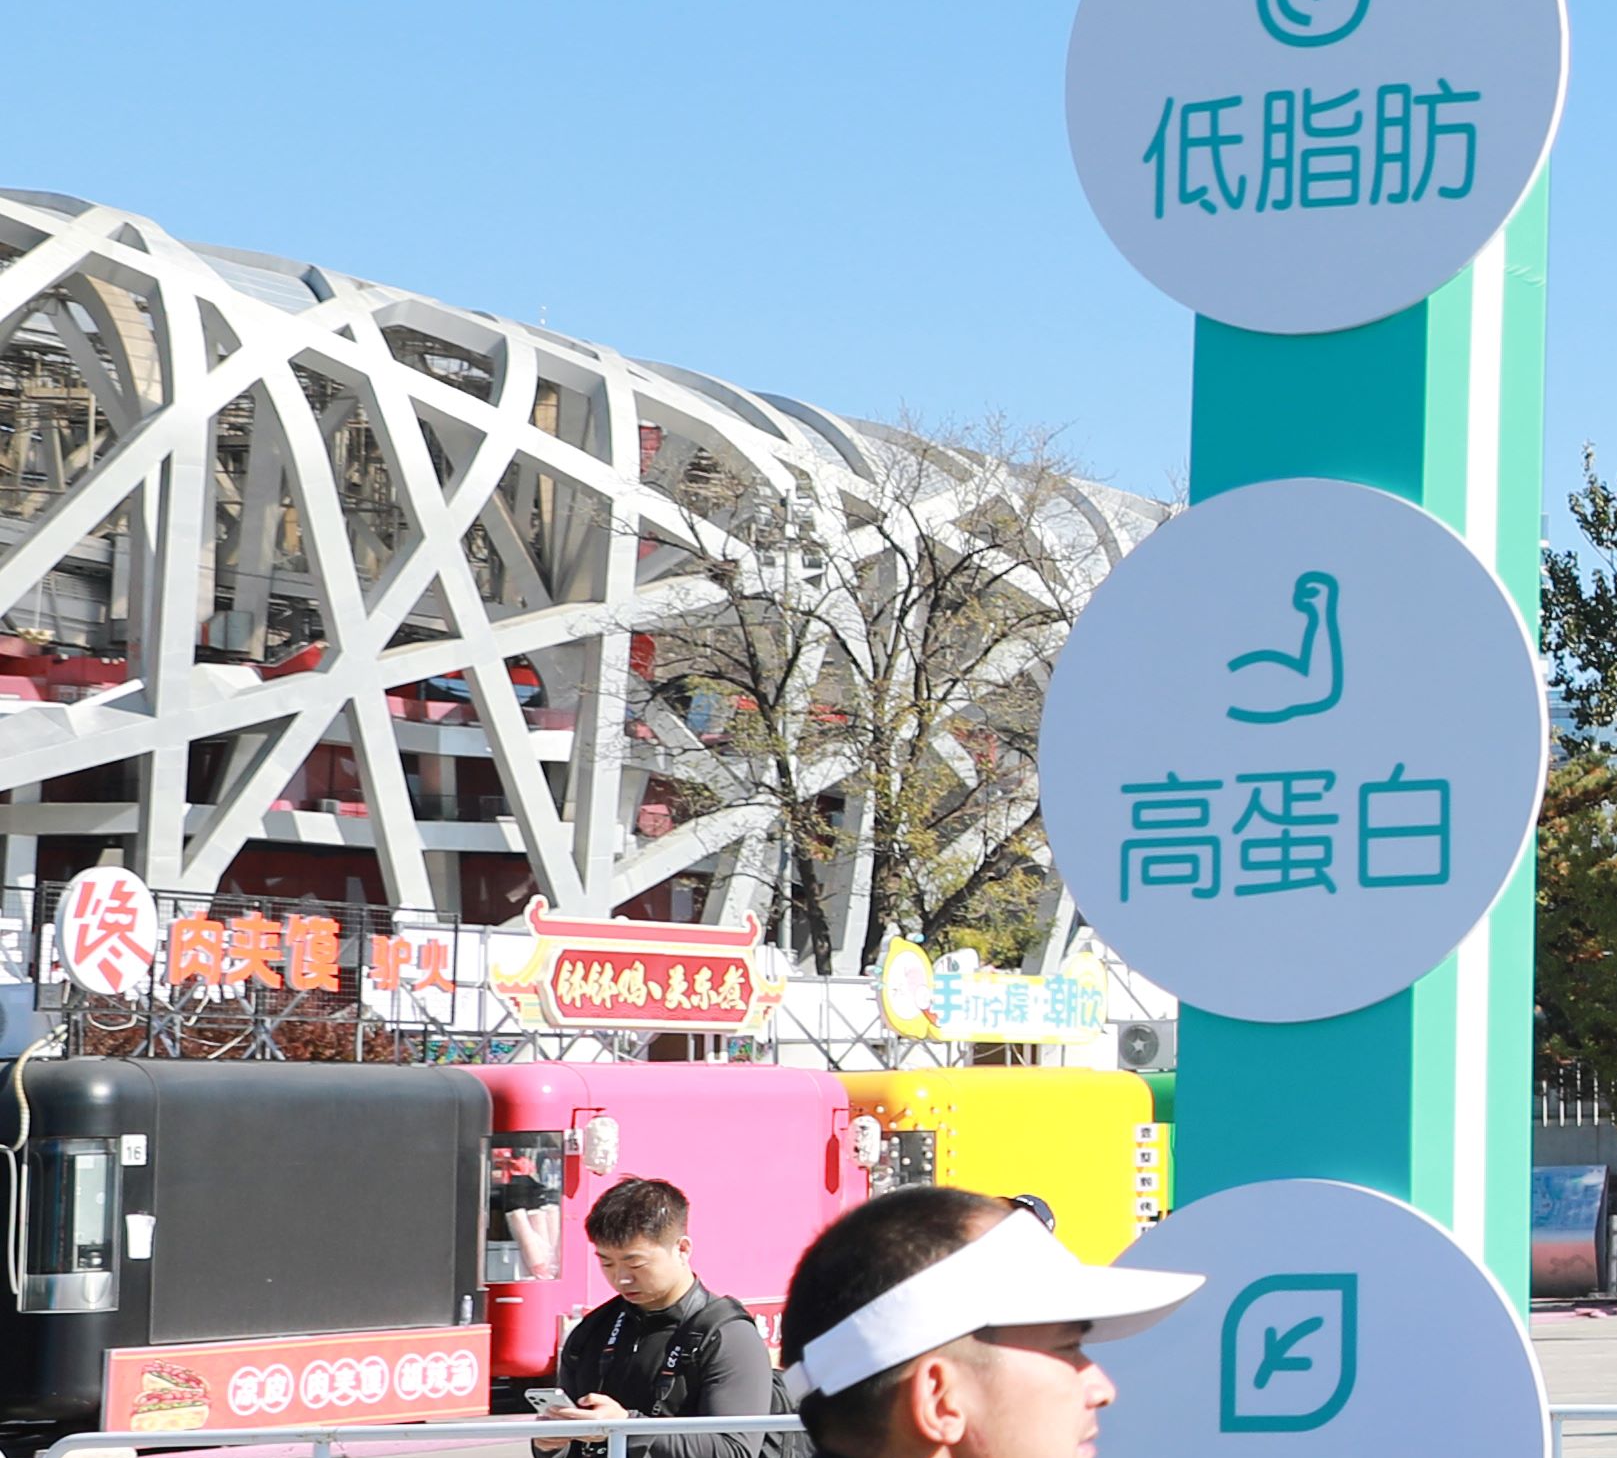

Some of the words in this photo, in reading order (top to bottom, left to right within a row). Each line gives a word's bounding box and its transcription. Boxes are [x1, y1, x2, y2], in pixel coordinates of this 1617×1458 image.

[1142, 78, 1481, 220] 低脂肪
[1120, 762, 1450, 903] 高蛋白
[168, 911, 342, 992] 肉夹馍
[126, 1146, 142, 1160] 16
[302, 1359, 388, 1406] 肉夹馍
